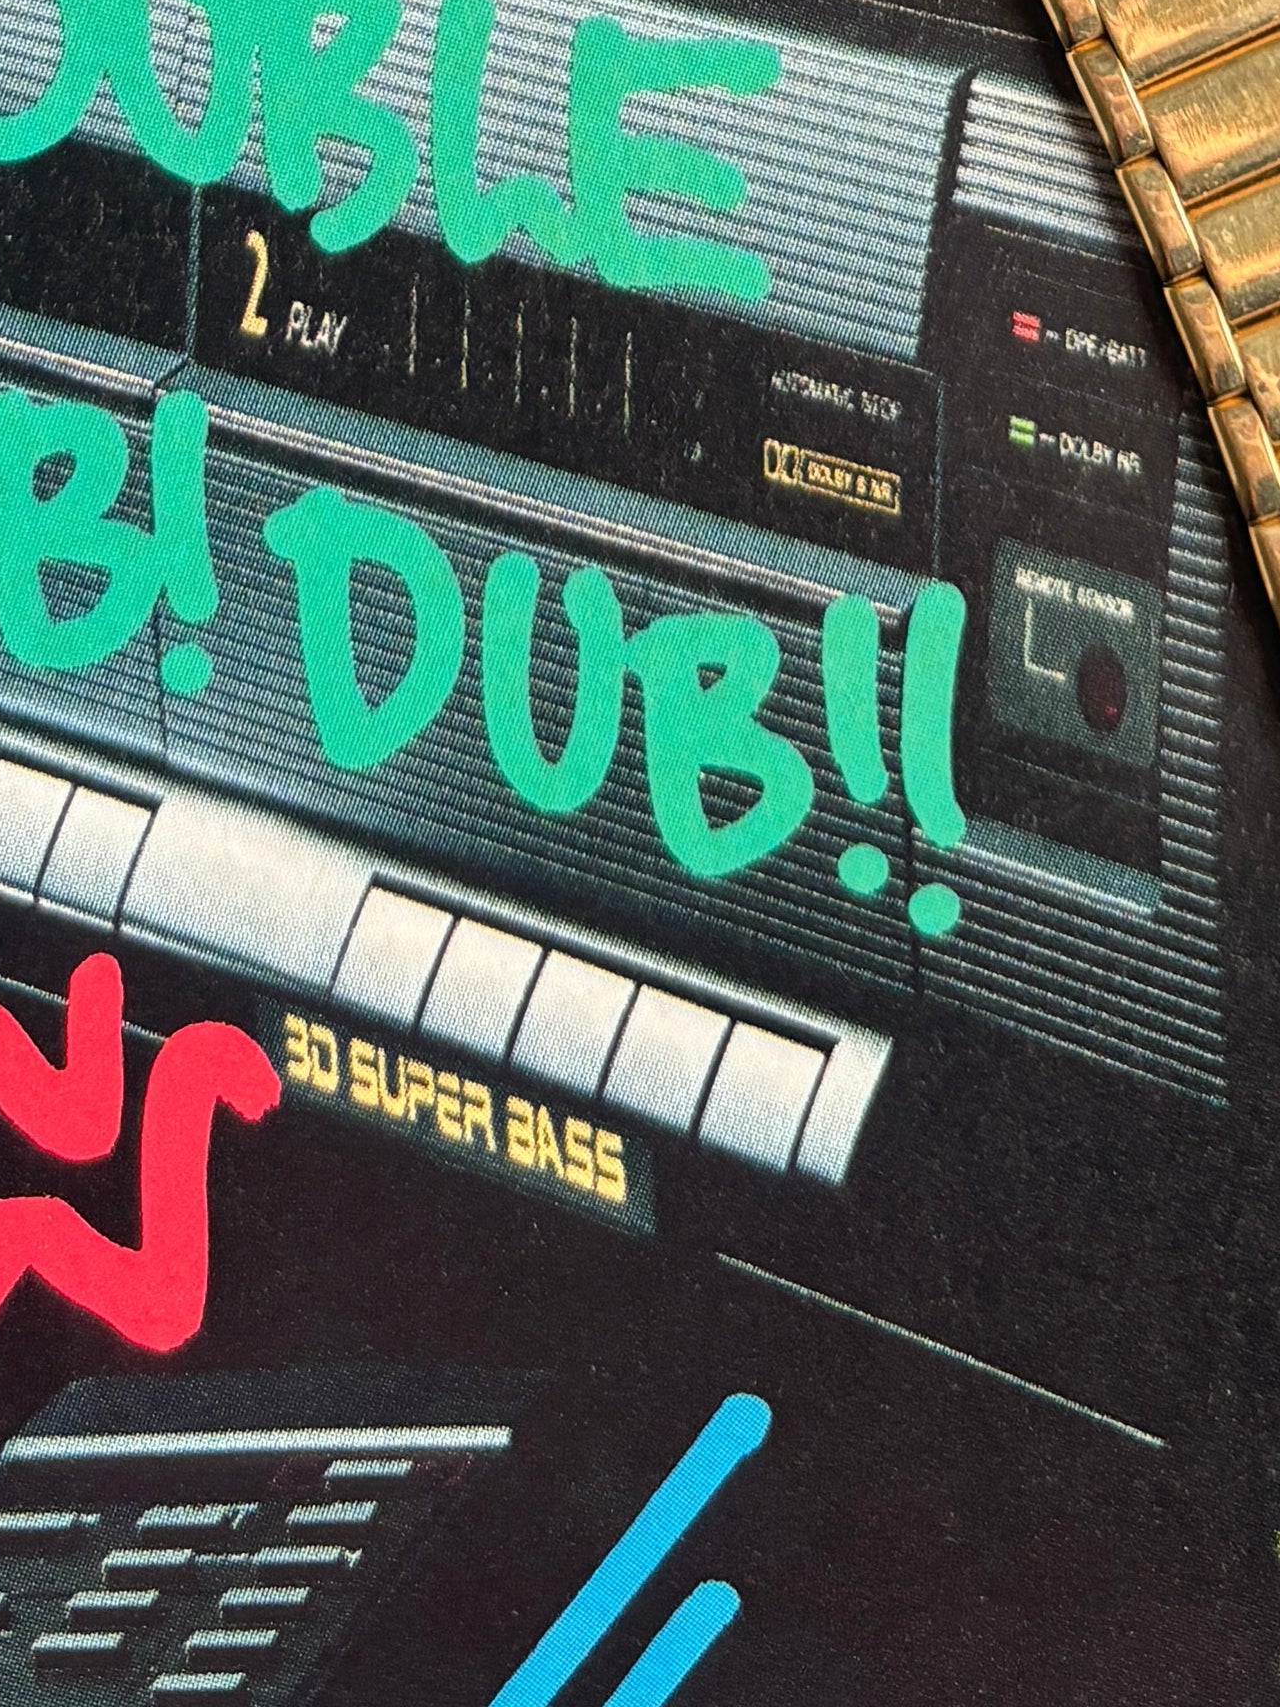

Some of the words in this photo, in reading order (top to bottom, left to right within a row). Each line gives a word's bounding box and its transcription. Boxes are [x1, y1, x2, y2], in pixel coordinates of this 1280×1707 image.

[238, 229, 270, 338] 2
[285, 299, 351, 360] PLAY
[257, 485, 966, 940] DUB!!
[284, 1012, 339, 1095] 3D
[348, 1037, 497, 1154] SUPER
[504, 1094, 627, 1204] BASS
